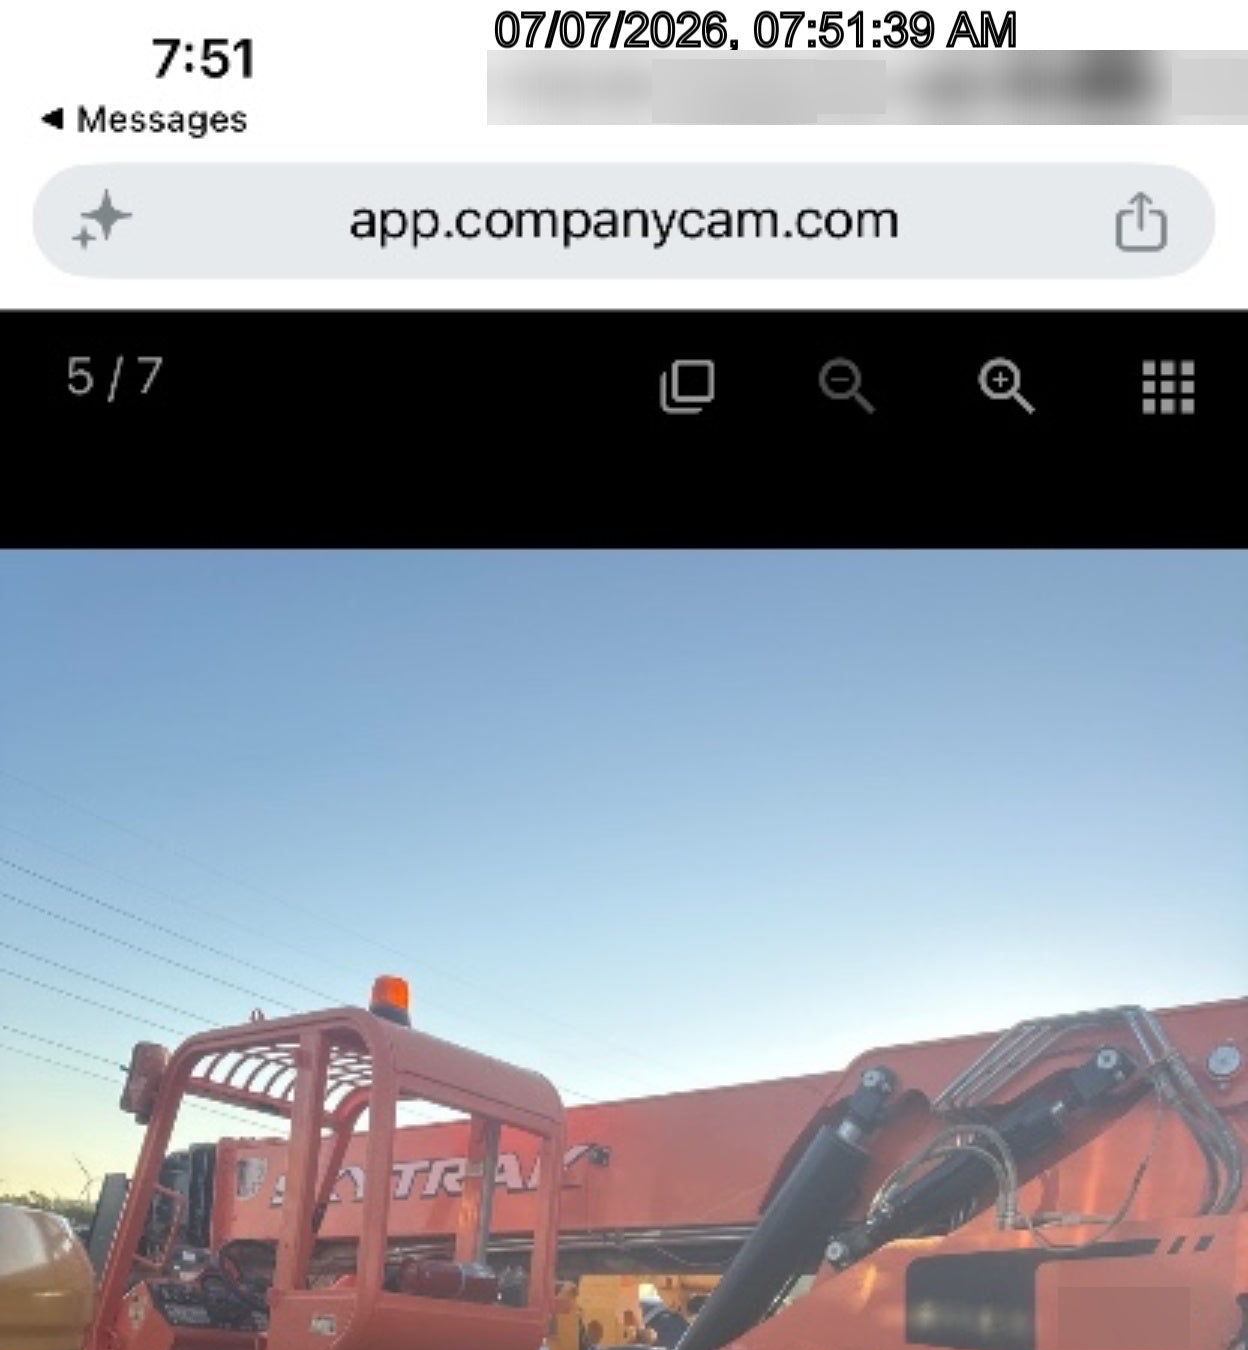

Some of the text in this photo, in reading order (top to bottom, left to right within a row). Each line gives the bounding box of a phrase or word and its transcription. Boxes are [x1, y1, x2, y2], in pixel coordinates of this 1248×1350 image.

[152, 38, 253, 79] 7:51
[78, 105, 248, 139] Messages
[350, 202, 899, 249] app.companycam.com
